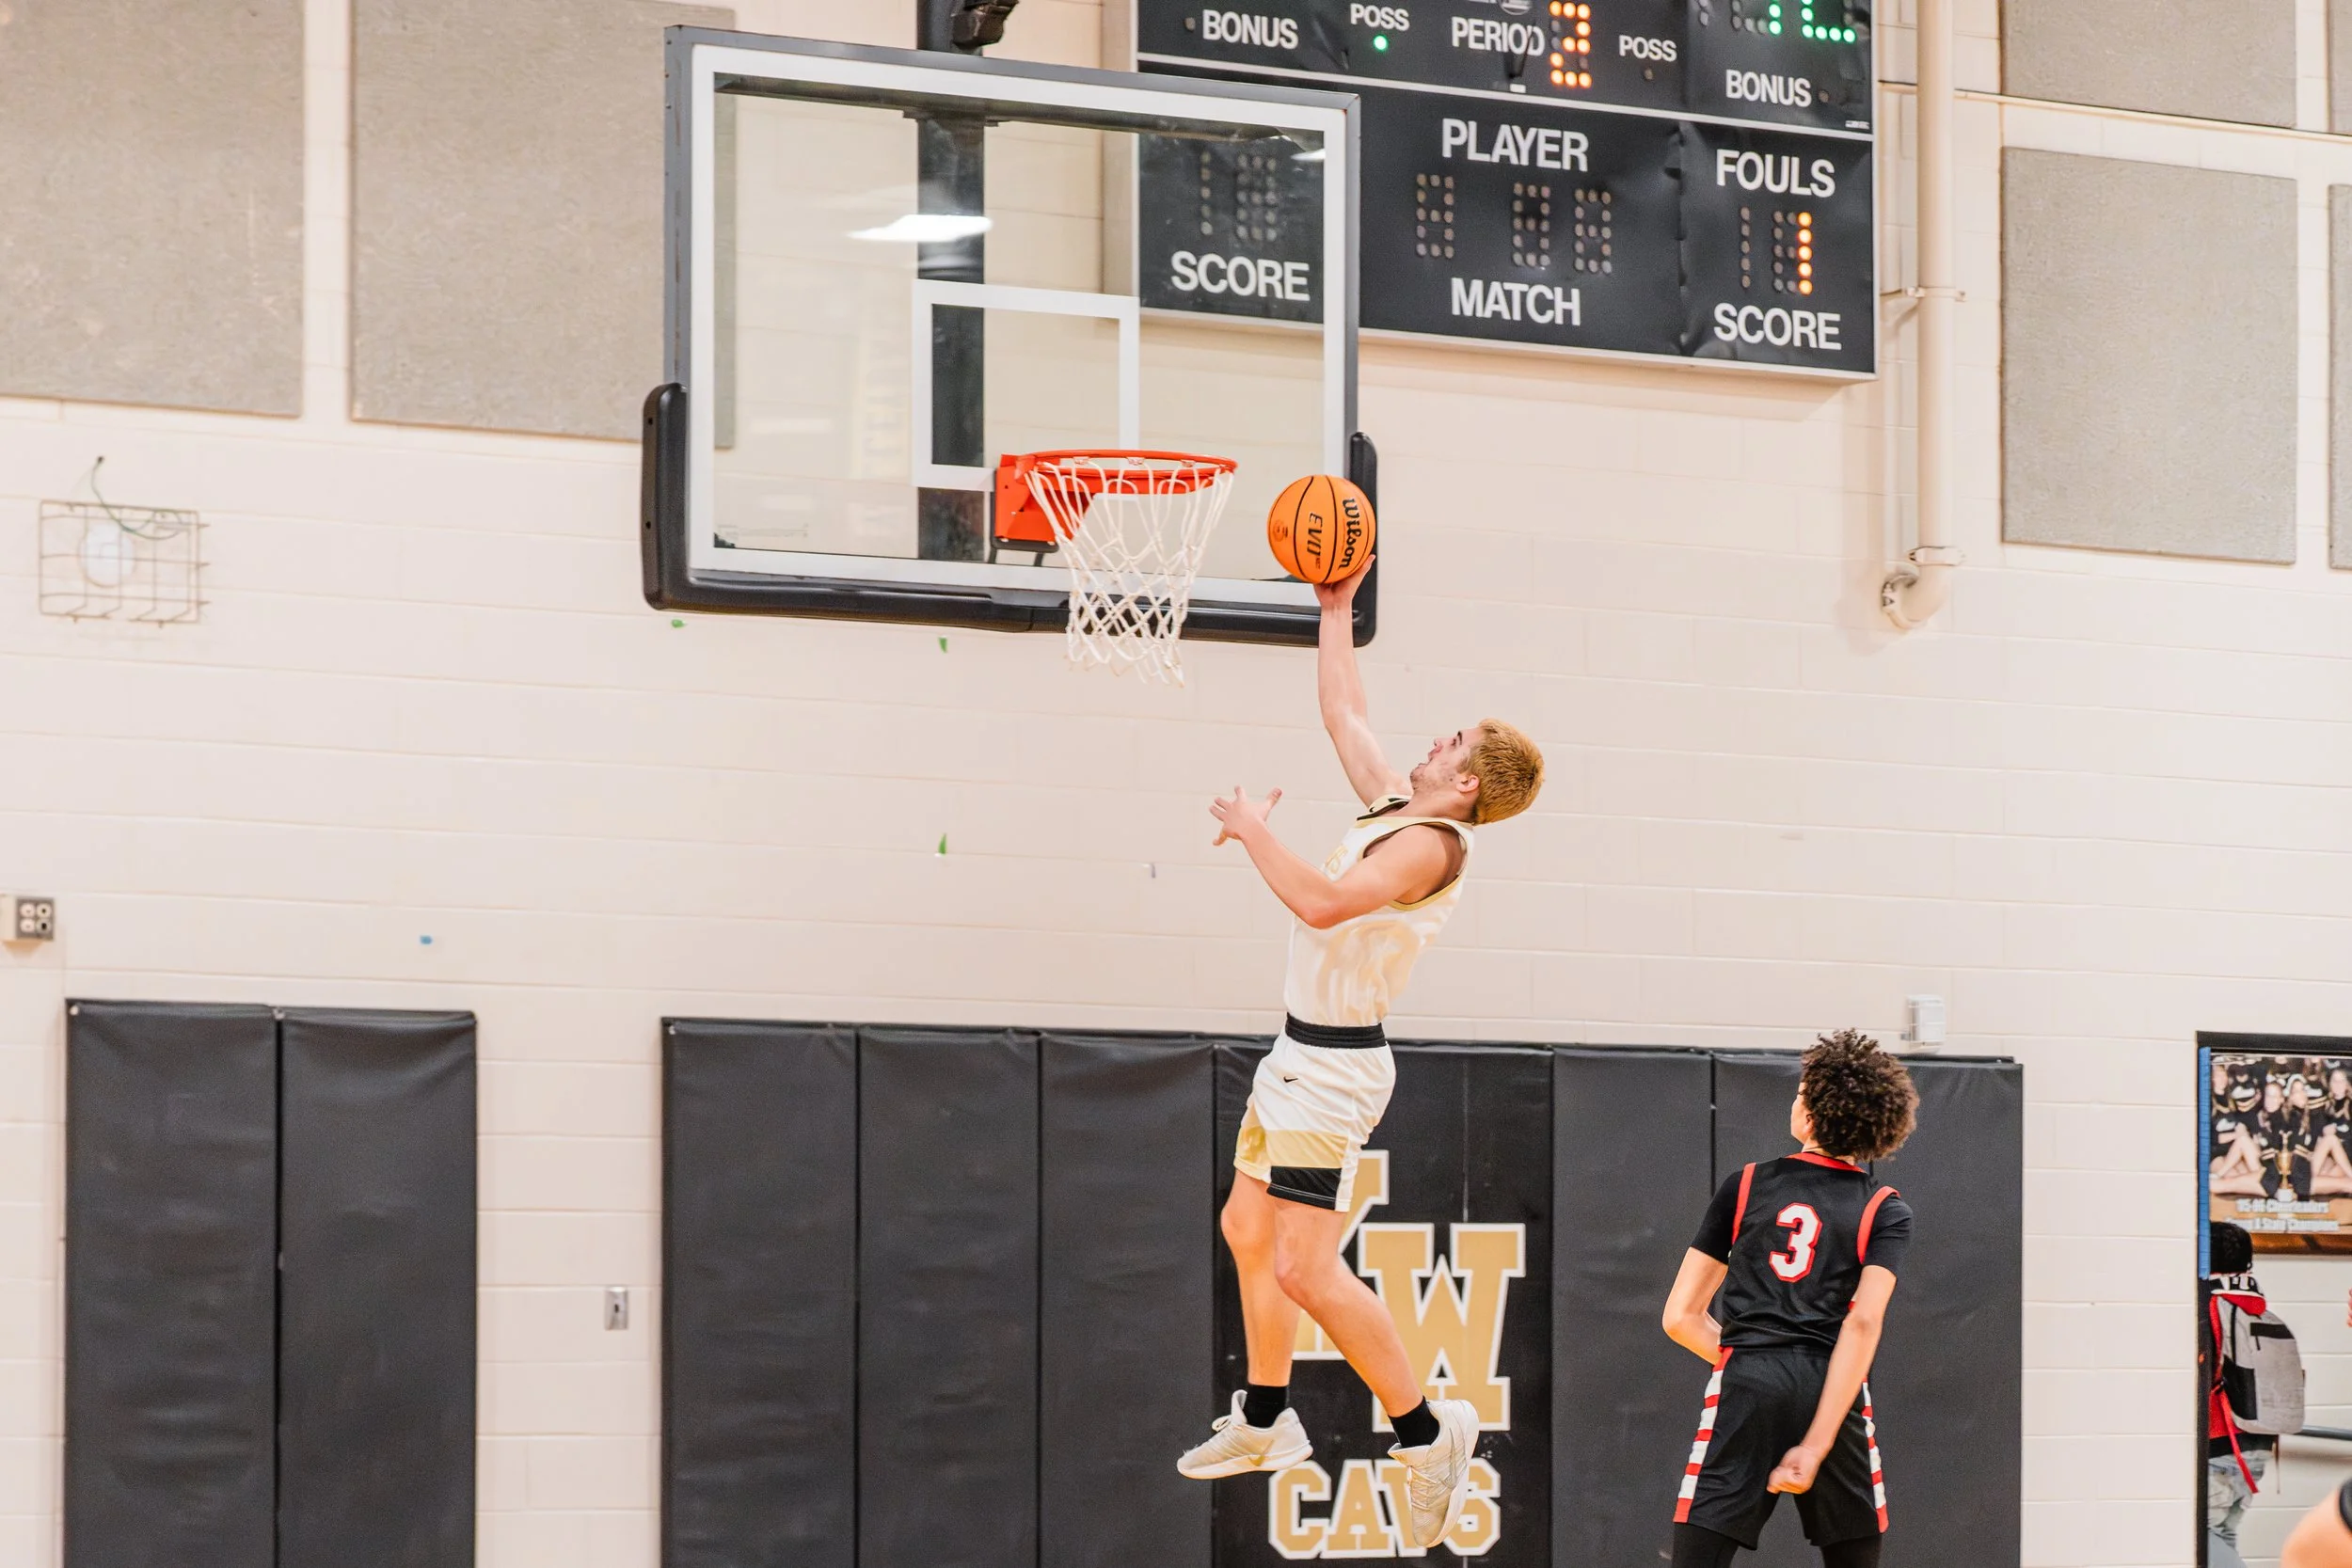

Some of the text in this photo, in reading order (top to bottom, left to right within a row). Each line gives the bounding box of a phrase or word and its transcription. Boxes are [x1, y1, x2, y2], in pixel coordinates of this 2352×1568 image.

[1202, 9, 1298, 49] BONUS
[1350, 3, 1409, 31] POSS
[1452, 16, 1545, 56] PERIOD
[1549, 1, 1592, 88] 2
[1619, 35, 1677, 61] POSS
[1726, 69, 1812, 107] BONUS
[1442, 118, 1589, 172] PLAYER
[1717, 149, 1836, 198] FOULS
[1171, 250, 1311, 302] SCORE
[1452, 277, 1581, 326] MATCH
[1713, 303, 1842, 350] SCORE
[1307, 513, 1323, 557] EVO
[1338, 499, 1362, 570] Wilson
[1769, 1202, 1822, 1283] 3
